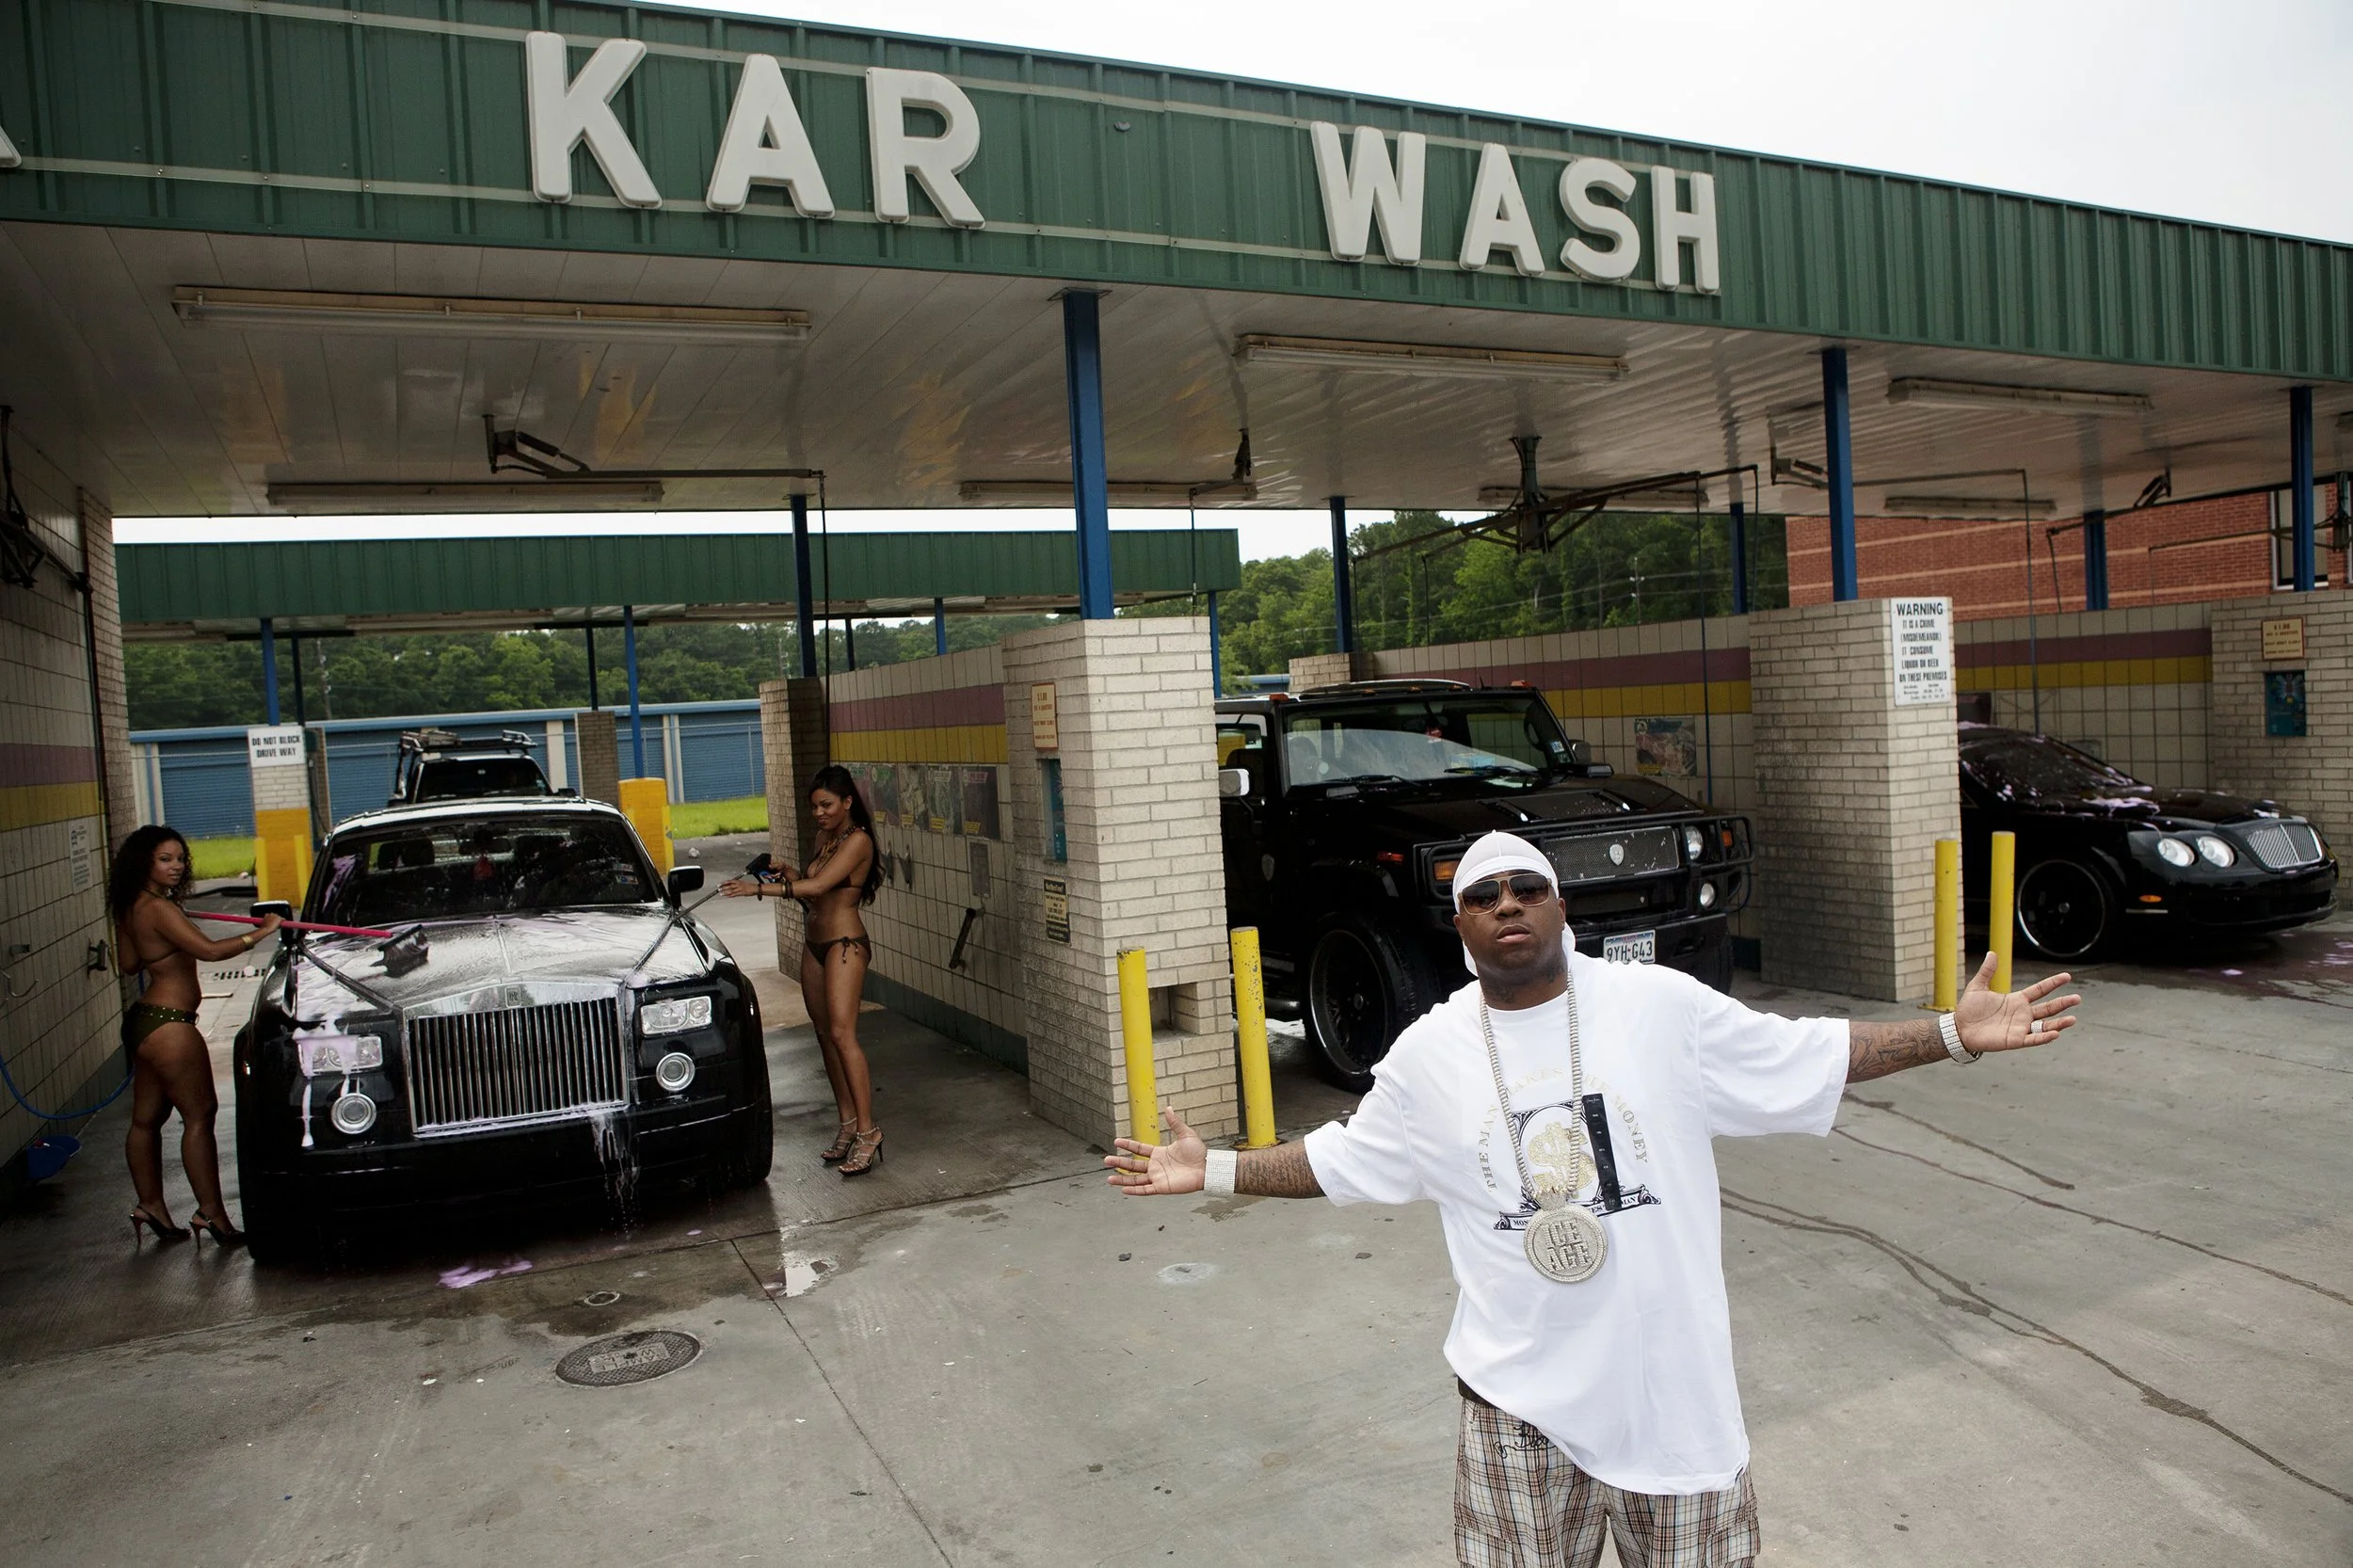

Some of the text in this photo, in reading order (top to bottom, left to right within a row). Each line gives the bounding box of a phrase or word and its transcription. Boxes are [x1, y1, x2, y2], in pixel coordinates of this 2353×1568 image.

[526, 31, 1720, 294] KAR WASH
[1897, 602, 1944, 616] WARNING
[1908, 672, 1921, 681] THESE
[1923, 671, 1947, 680] PREMISES
[280, 735, 301, 744] BLOCK
[257, 747, 296, 758] DRIVE WAY
[1613, 1095, 1648, 1163] MONEY
[1543, 1218, 1582, 1249] ICE
[1546, 1241, 1593, 1272] AGE
